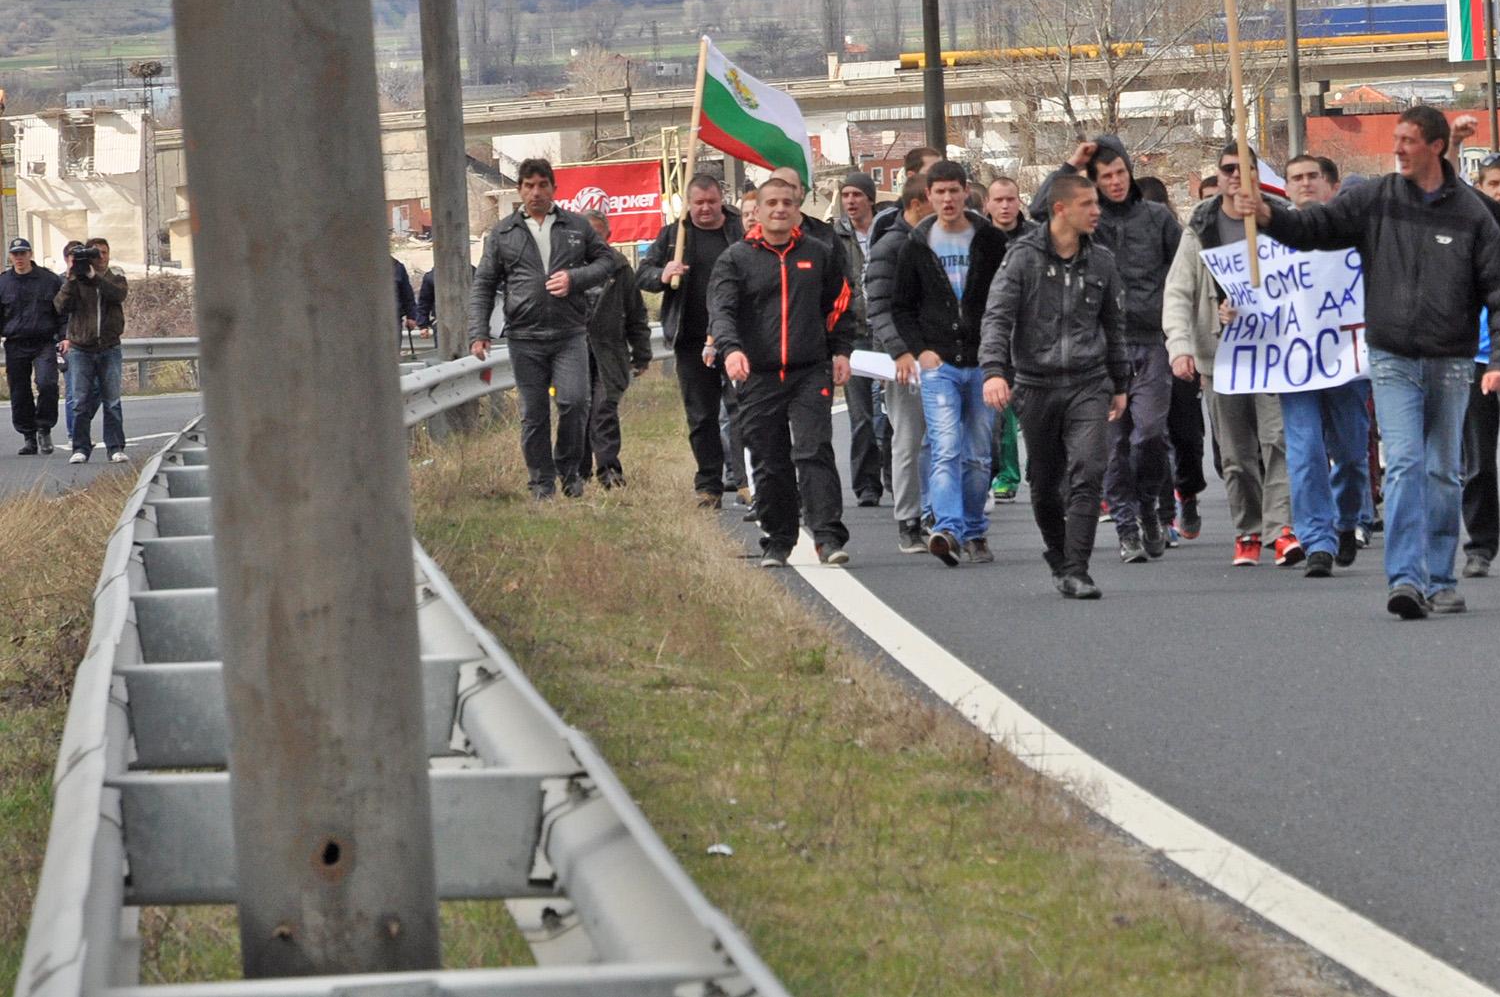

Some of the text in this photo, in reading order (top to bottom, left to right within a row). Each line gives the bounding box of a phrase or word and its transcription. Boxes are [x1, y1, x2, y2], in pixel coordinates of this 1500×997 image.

[1205, 241, 1297, 277] НИЕ СМ
[1223, 280, 1257, 308] НИЕ
[1264, 261, 1314, 299] СМЕ
[1224, 288, 1357, 343] НЯМА ДА
[1230, 322, 1368, 391] ПРОСТ
